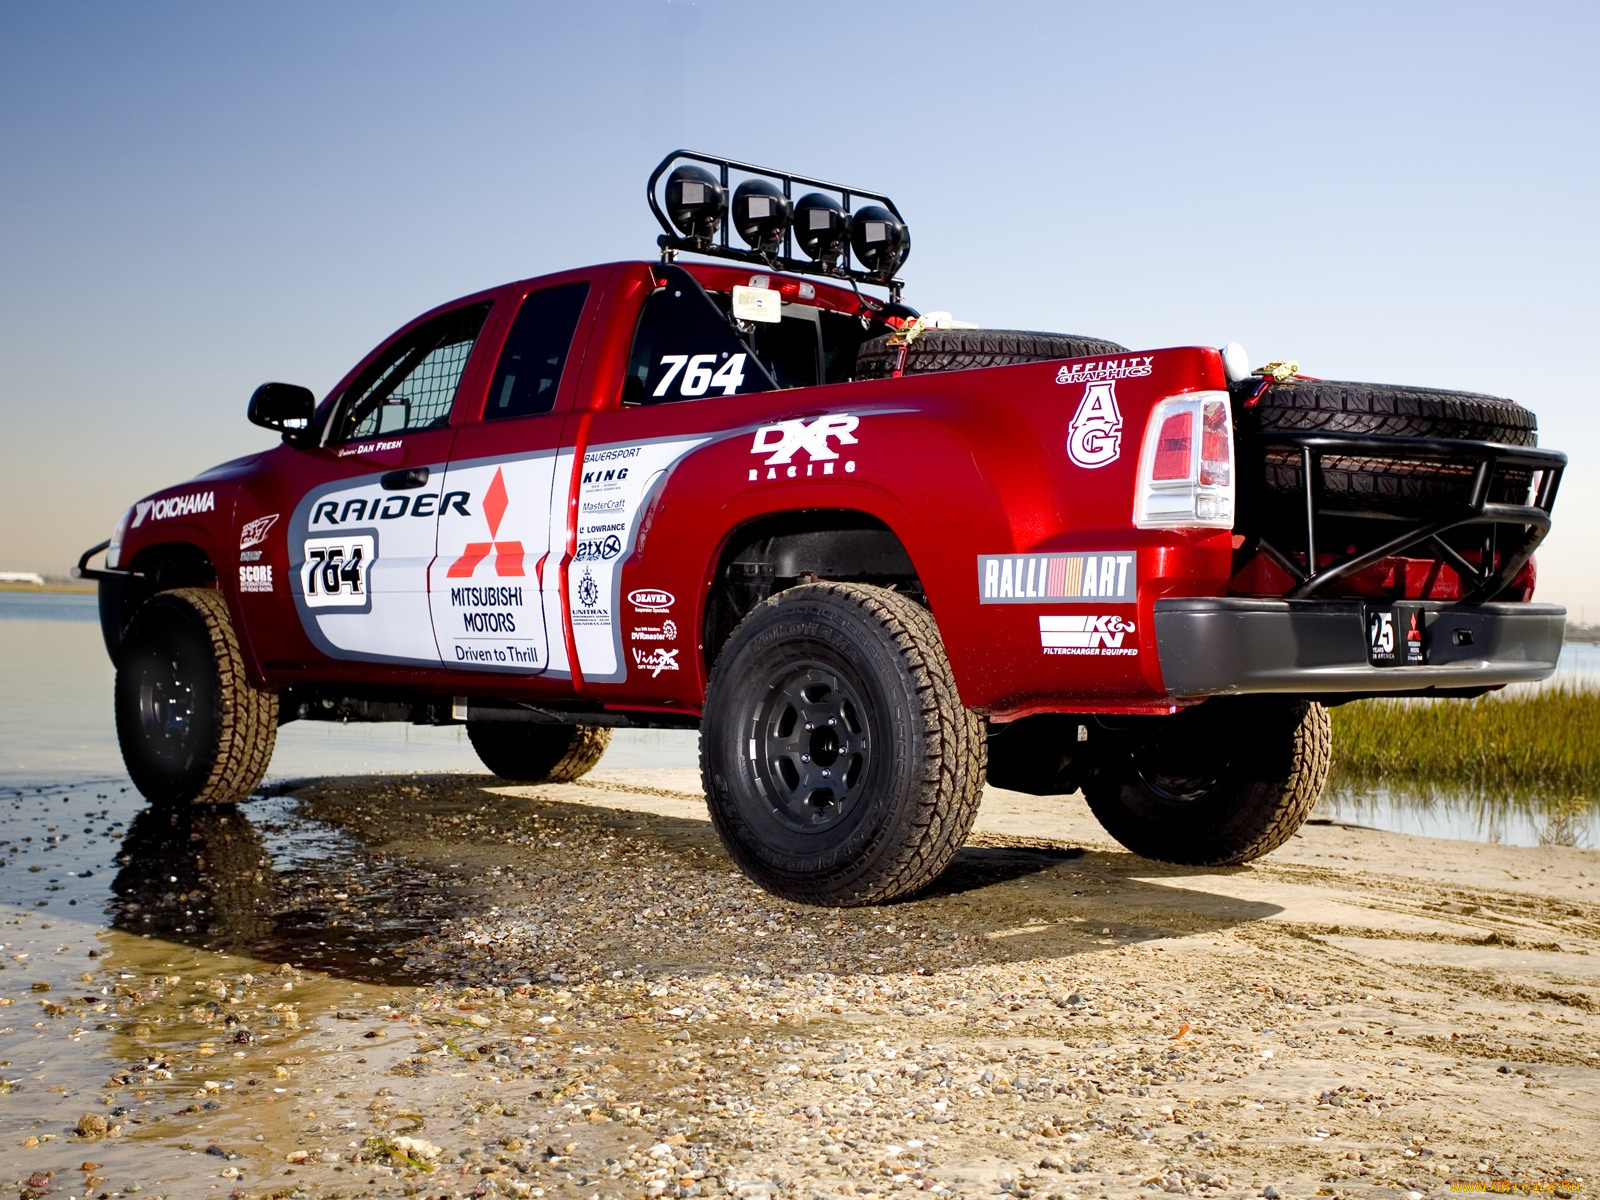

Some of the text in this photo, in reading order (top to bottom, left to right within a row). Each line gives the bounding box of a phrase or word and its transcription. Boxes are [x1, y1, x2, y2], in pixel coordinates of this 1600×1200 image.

[1058, 356, 1154, 375] AFFINITY
[653, 353, 747, 397] 764
[1056, 366, 1152, 384] GRAPHICS
[357, 445, 375, 454] DAN
[376, 440, 403, 451] FRESH
[750, 413, 859, 465] DXR
[584, 448, 641, 463] BAUERSPORT
[583, 468, 629, 483] KING
[749, 461, 856, 481] RACING
[150, 491, 215, 521] YOKOHAMA
[312, 490, 472, 525] RAIDER
[583, 499, 626, 511] MasterCraft
[587, 523, 626, 533] LOWRANCE
[239, 565, 273, 581] SCORE
[307, 545, 366, 596] 764
[451, 586, 523, 607] MITSUBISHI
[635, 593, 667, 603] DEAVER
[464, 613, 516, 633] MOTORS
[1370, 612, 1394, 653] 25
[455, 645, 538, 663] Driven to Thrill
[1043, 648, 1100, 656] FILTERCHARGER
